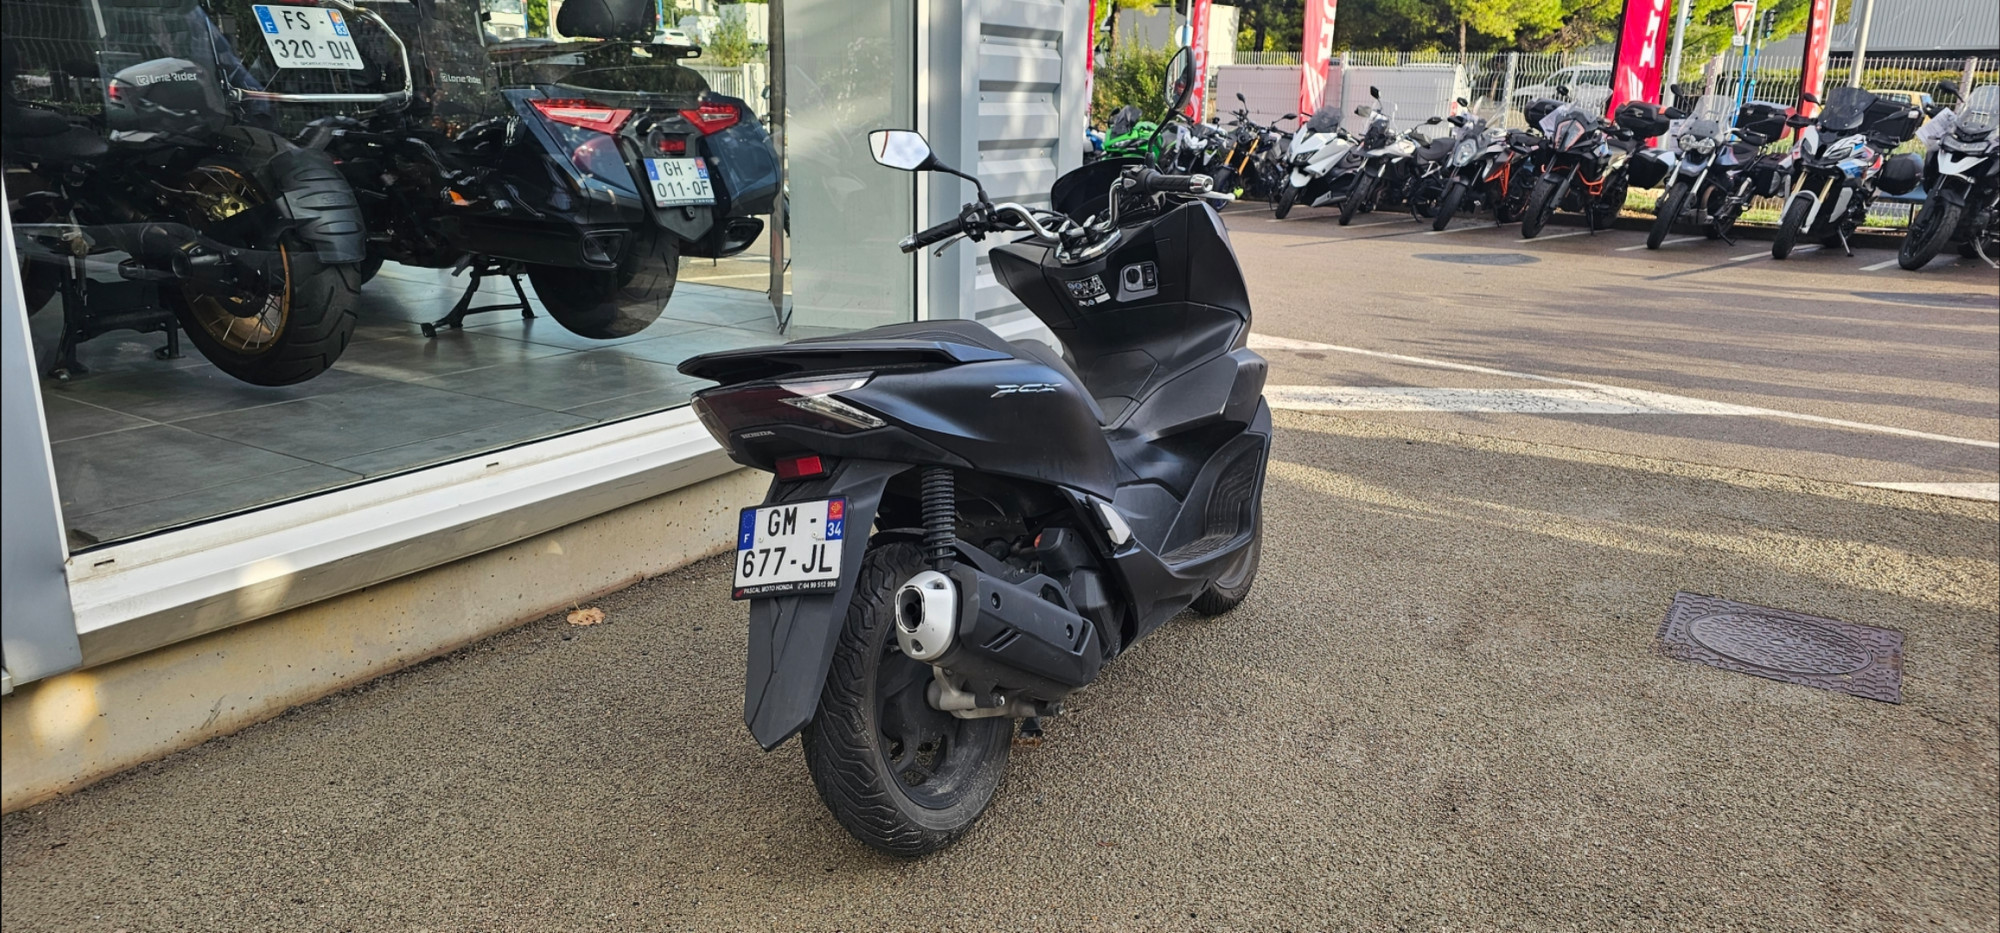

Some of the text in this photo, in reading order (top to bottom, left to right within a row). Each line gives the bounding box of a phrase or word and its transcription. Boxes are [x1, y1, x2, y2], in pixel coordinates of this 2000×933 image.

[282, 10, 310, 30] FS
[275, 39, 355, 60] 320-DH
[170, 72, 197, 82] Rider
[664, 161, 683, 176] GH
[768, 507, 798, 537] GM
[827, 522, 842, 536] 34
[743, 533, 750, 543] F
[742, 544, 832, 578] 677-JL
